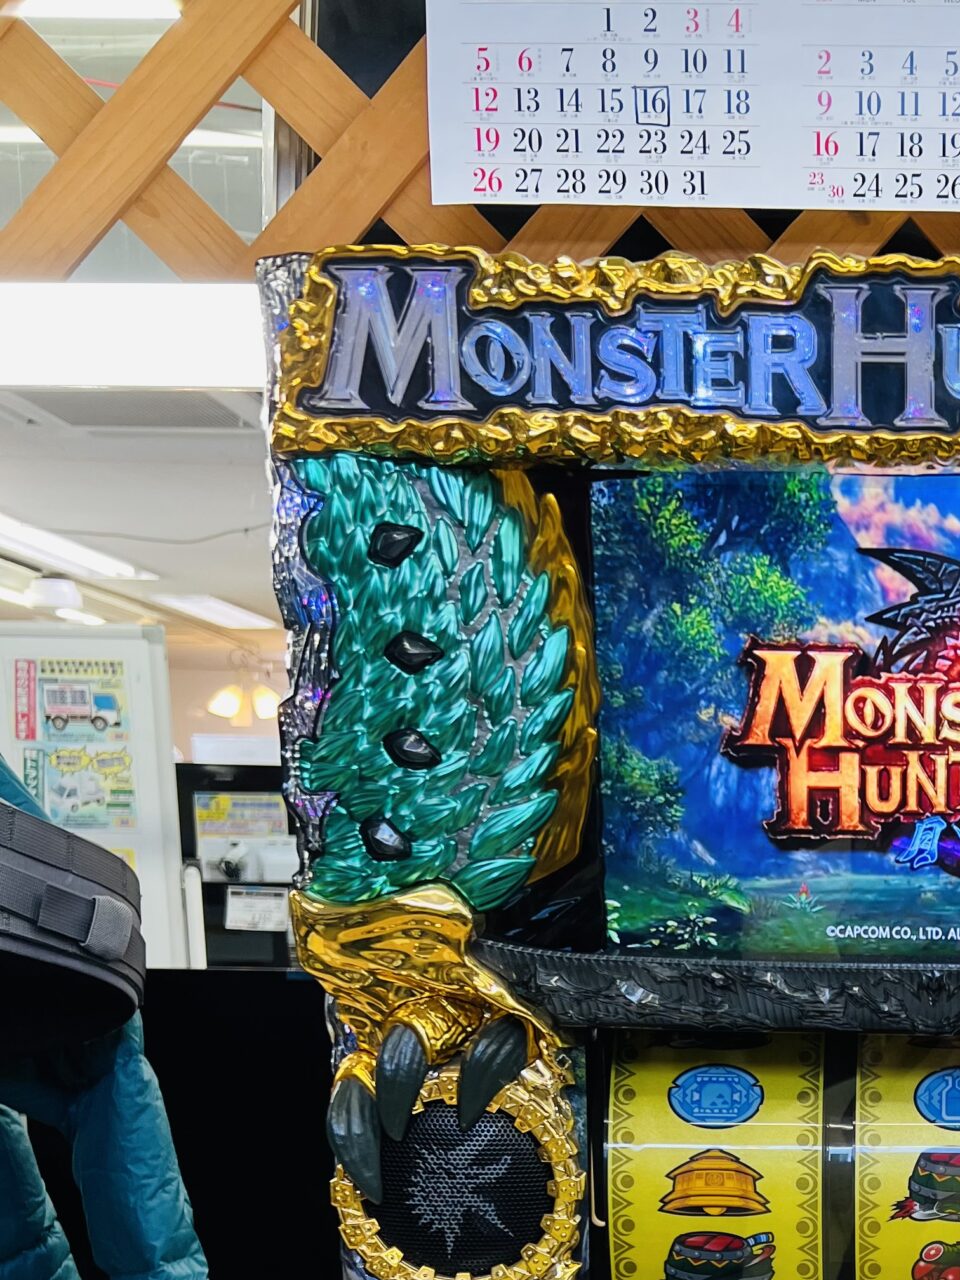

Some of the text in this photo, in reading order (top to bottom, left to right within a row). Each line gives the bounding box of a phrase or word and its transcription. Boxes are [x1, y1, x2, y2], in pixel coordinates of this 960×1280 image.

[603, 7, 742, 33] 1 2 3 4
[476, 47, 747, 74] 5 6 7 8 9 10 11
[817, 49, 831, 75] 2
[860, 50, 874, 76] 3
[902, 50, 917, 76] 4
[945, 51, 959, 77] 5
[472, 87, 750, 115] 12 13 14 15 16 17 18
[817, 90, 832, 115] 9
[855, 90, 881, 116] 10
[897, 91, 920, 117] 11
[474, 127, 751, 156] 19 20 21 22 23 24 25
[812, 130, 839, 157] 16
[856, 132, 880, 157] 17
[896, 132, 923, 158] 18
[473, 167, 708, 196] 26 27 28 29 30 31
[808, 172, 824, 186] 23
[828, 184, 844, 198] 30
[853, 172, 883, 198] 24
[895, 173, 923, 199] 25
[303, 264, 827, 411] MONSTER
[919, 927, 945, 940] LTD.
